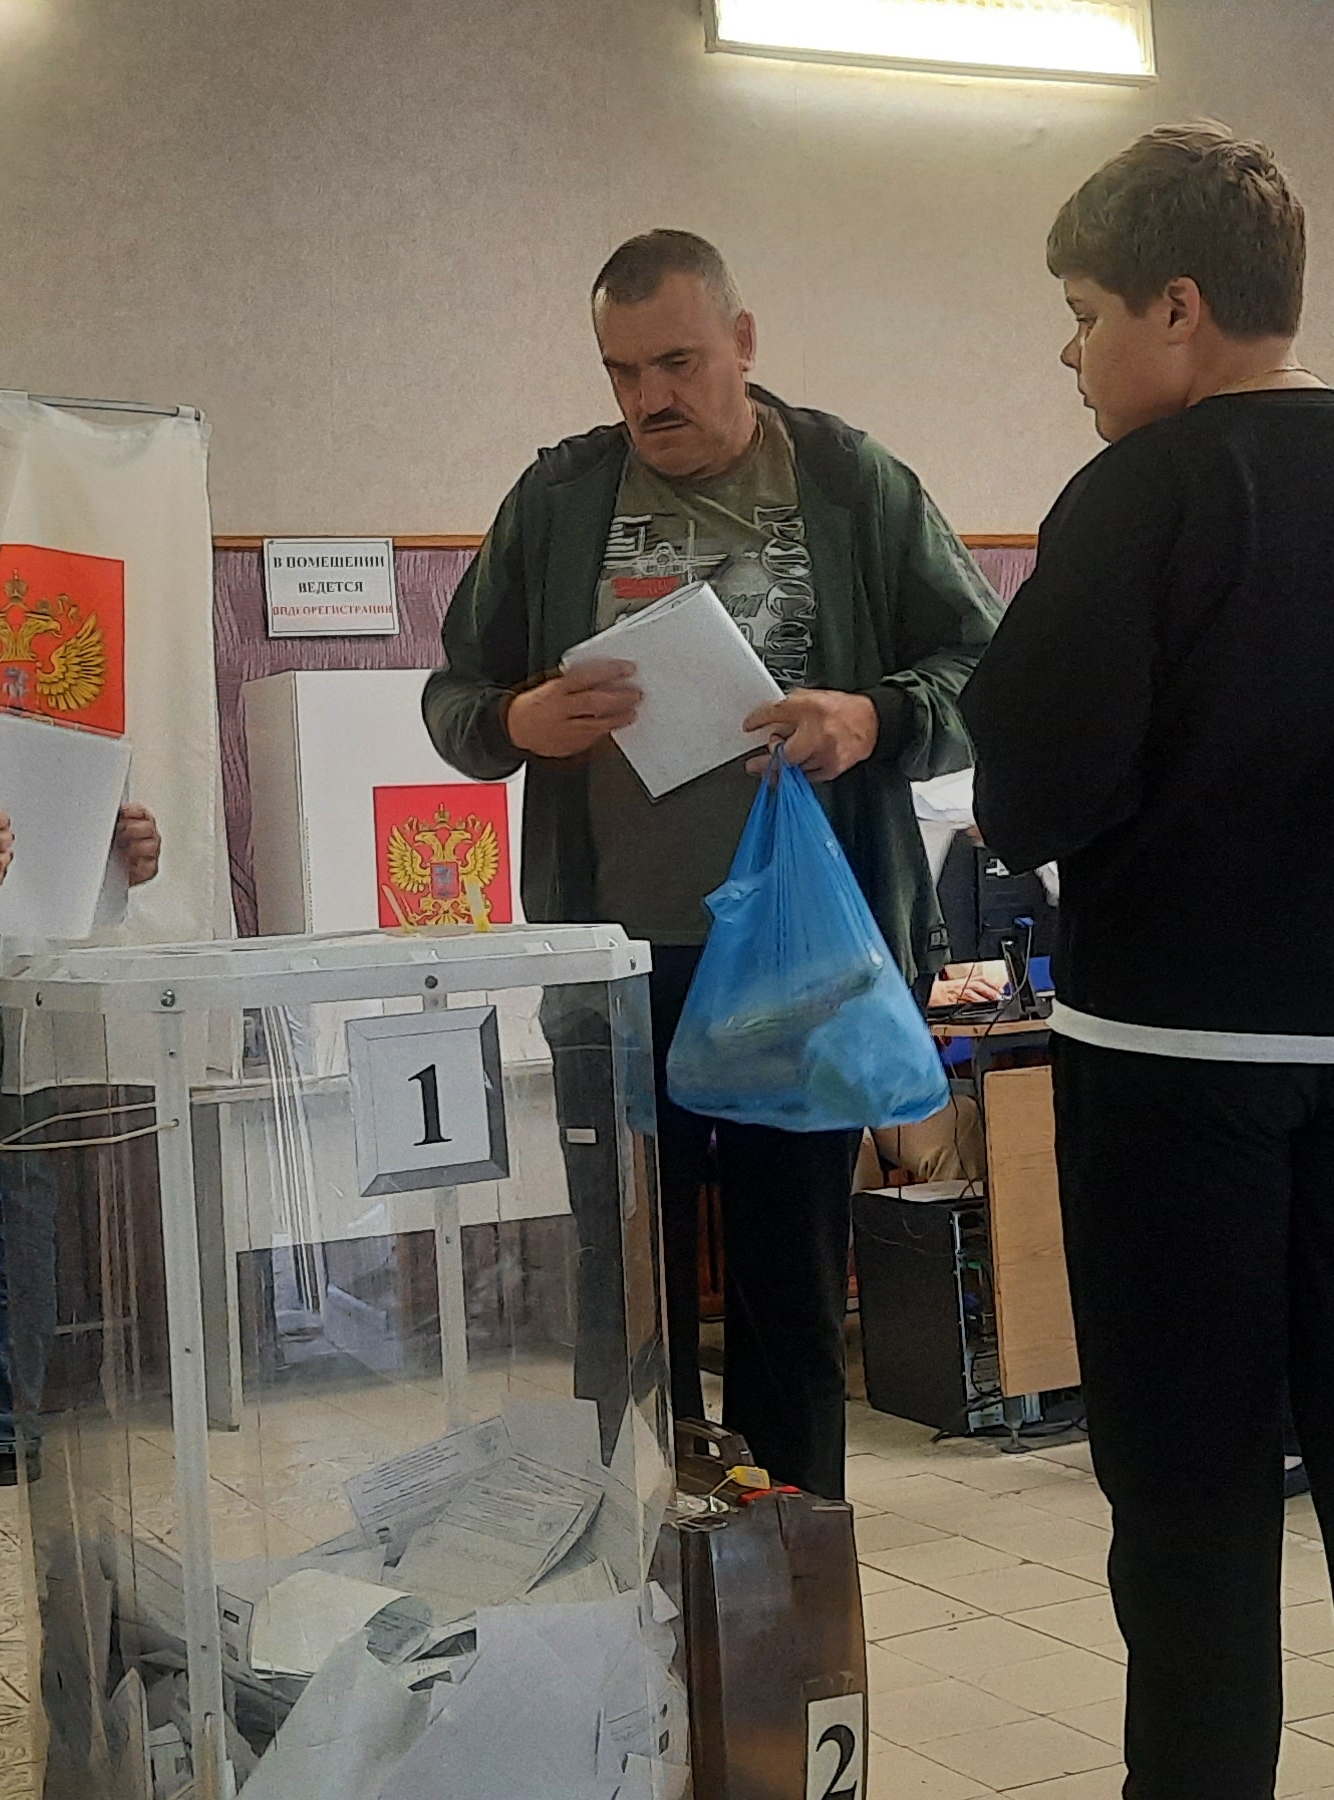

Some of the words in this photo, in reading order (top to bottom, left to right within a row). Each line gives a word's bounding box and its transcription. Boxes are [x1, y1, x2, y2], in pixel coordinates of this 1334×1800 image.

[273, 556, 282, 568] В
[286, 555, 385, 569] ПОМЕЩЕНИИ
[298, 581, 364, 594] ВЕДЕТСЯ
[753, 504, 818, 687] РОССИ
[272, 604, 393, 617] ВИДЕОРЕГИСТРАЦИЯ
[407, 1064, 452, 1146] 1
[816, 1724, 857, 1800] 2
